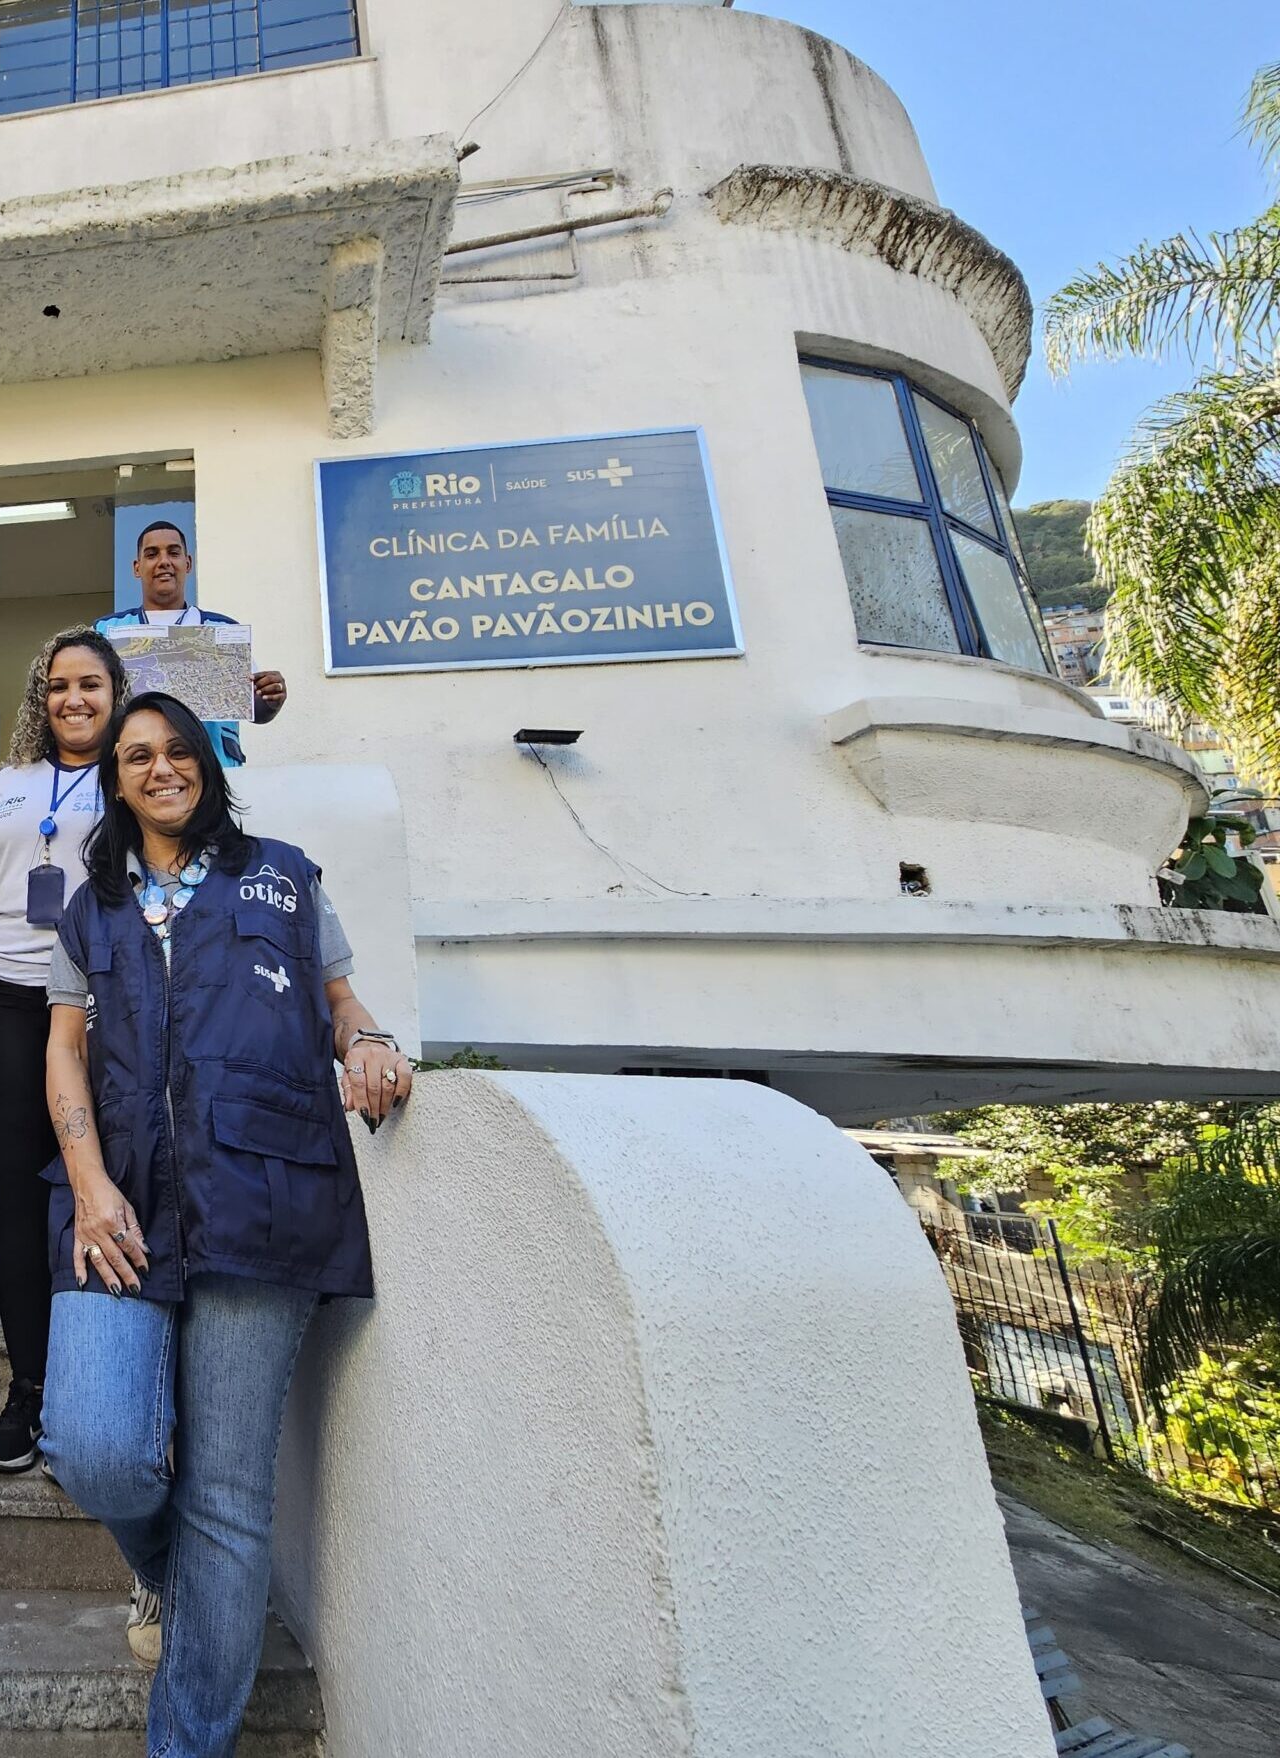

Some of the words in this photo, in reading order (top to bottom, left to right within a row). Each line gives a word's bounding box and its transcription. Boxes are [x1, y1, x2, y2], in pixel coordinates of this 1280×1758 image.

[425, 472, 480, 497] Rio
[505, 477, 548, 491] SAÚDE
[567, 469, 596, 482] SUS
[393, 497, 482, 511] PREFEITURA
[369, 528, 489, 558] CLÍNICA
[497, 527, 540, 549] DA
[548, 514, 670, 545] FAMÍLIA
[410, 564, 634, 601] CANTAGALO
[346, 610, 460, 645] PAVÃO
[472, 602, 715, 639] PAVÃOZINHO
[239, 882, 297, 913] otics
[253, 964, 272, 980] SUS
